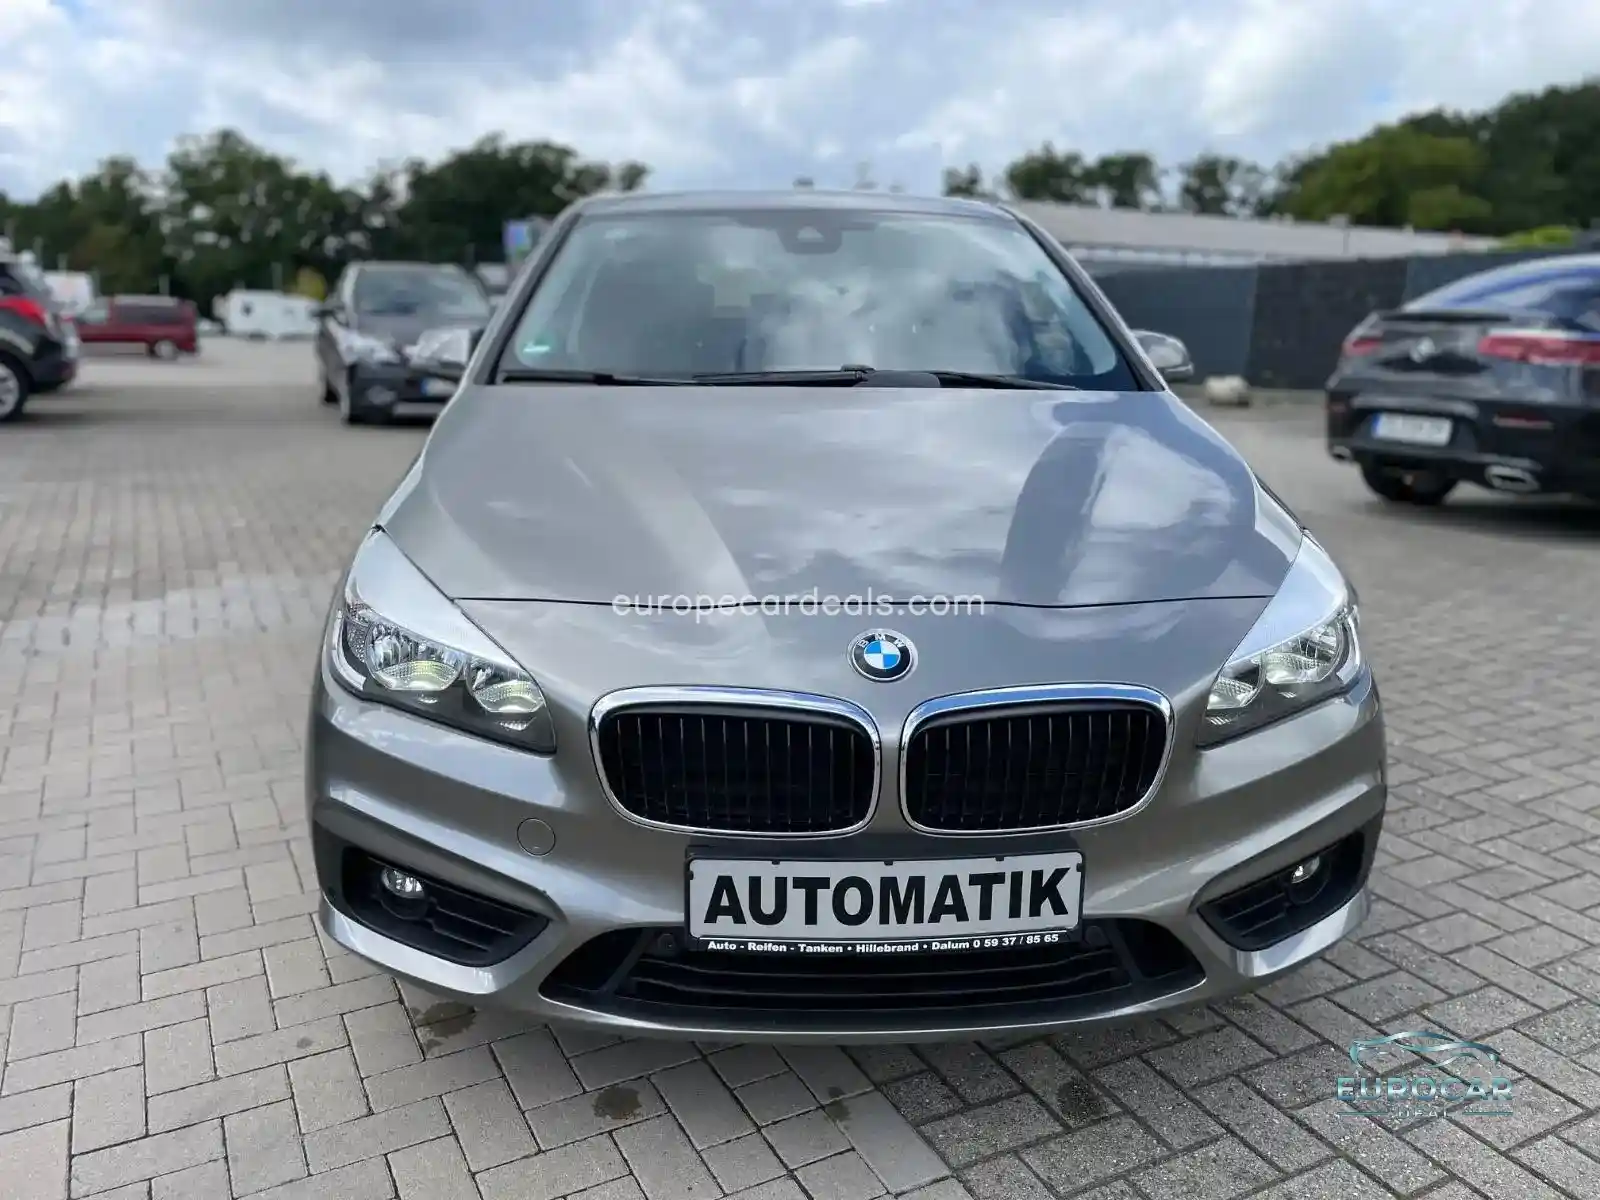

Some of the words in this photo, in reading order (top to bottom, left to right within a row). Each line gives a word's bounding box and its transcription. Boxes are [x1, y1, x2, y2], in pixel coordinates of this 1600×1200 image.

[857, 633, 906, 648] BMW
[703, 867, 1070, 926] AUTOMATIK
[708, 941, 737, 950] Auto
[747, 942, 787, 952] Reifen
[798, 943, 843, 953] Tanken
[856, 943, 919, 953] Hillebrand
[931, 941, 970, 950] Dalum
[973, 940, 981, 948] 0
[984, 938, 999, 947] 59
[1002, 937, 1017, 946] 37
[1026, 935, 1041, 944] 85
[1044, 934, 1059, 943] 65
